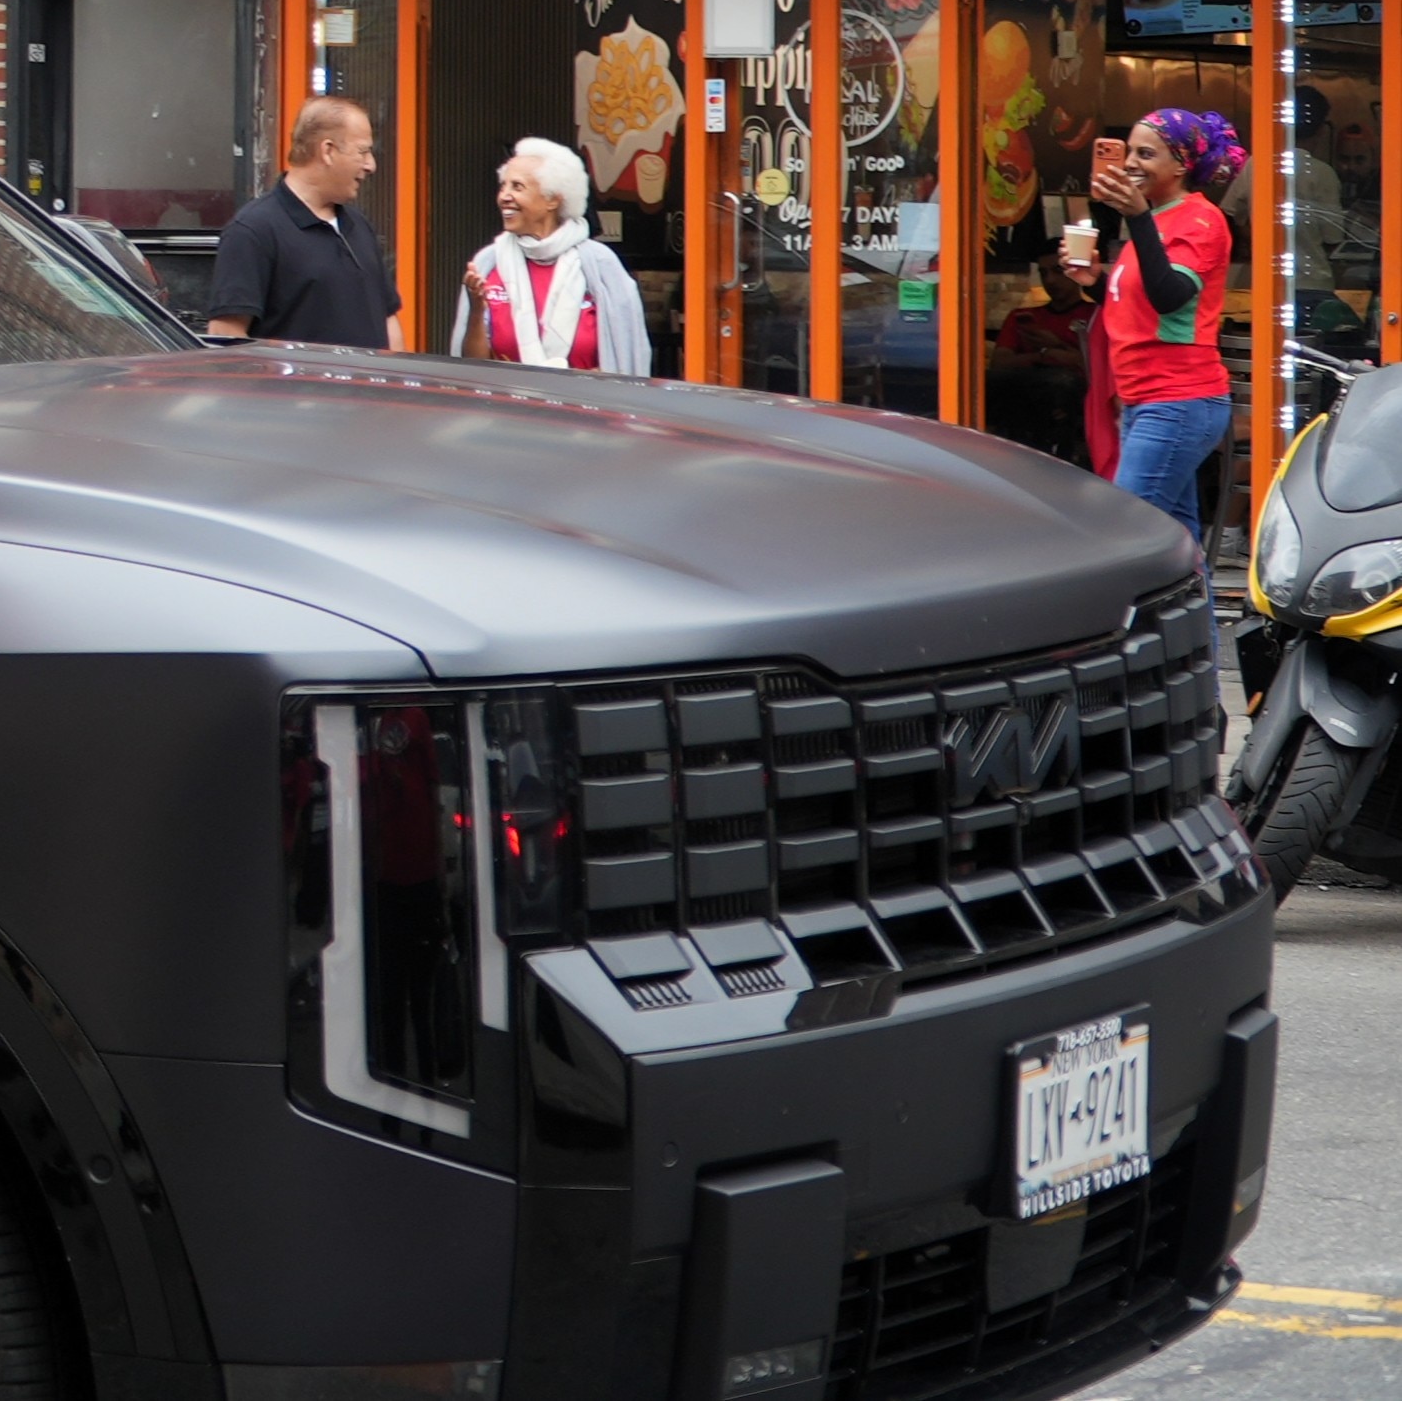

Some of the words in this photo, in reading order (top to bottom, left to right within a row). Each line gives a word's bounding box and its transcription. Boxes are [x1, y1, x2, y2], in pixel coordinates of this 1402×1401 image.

[780, 196, 812, 229] Op
[852, 234, 863, 251] 3
[868, 234, 899, 251] AM
[1053, 1048, 1081, 1078] NEW
[1085, 1035, 1119, 1068] YORK
[1020, 1176, 1090, 1219] HILLSIDE
[1093, 1154, 1151, 1191] TOYOTA
